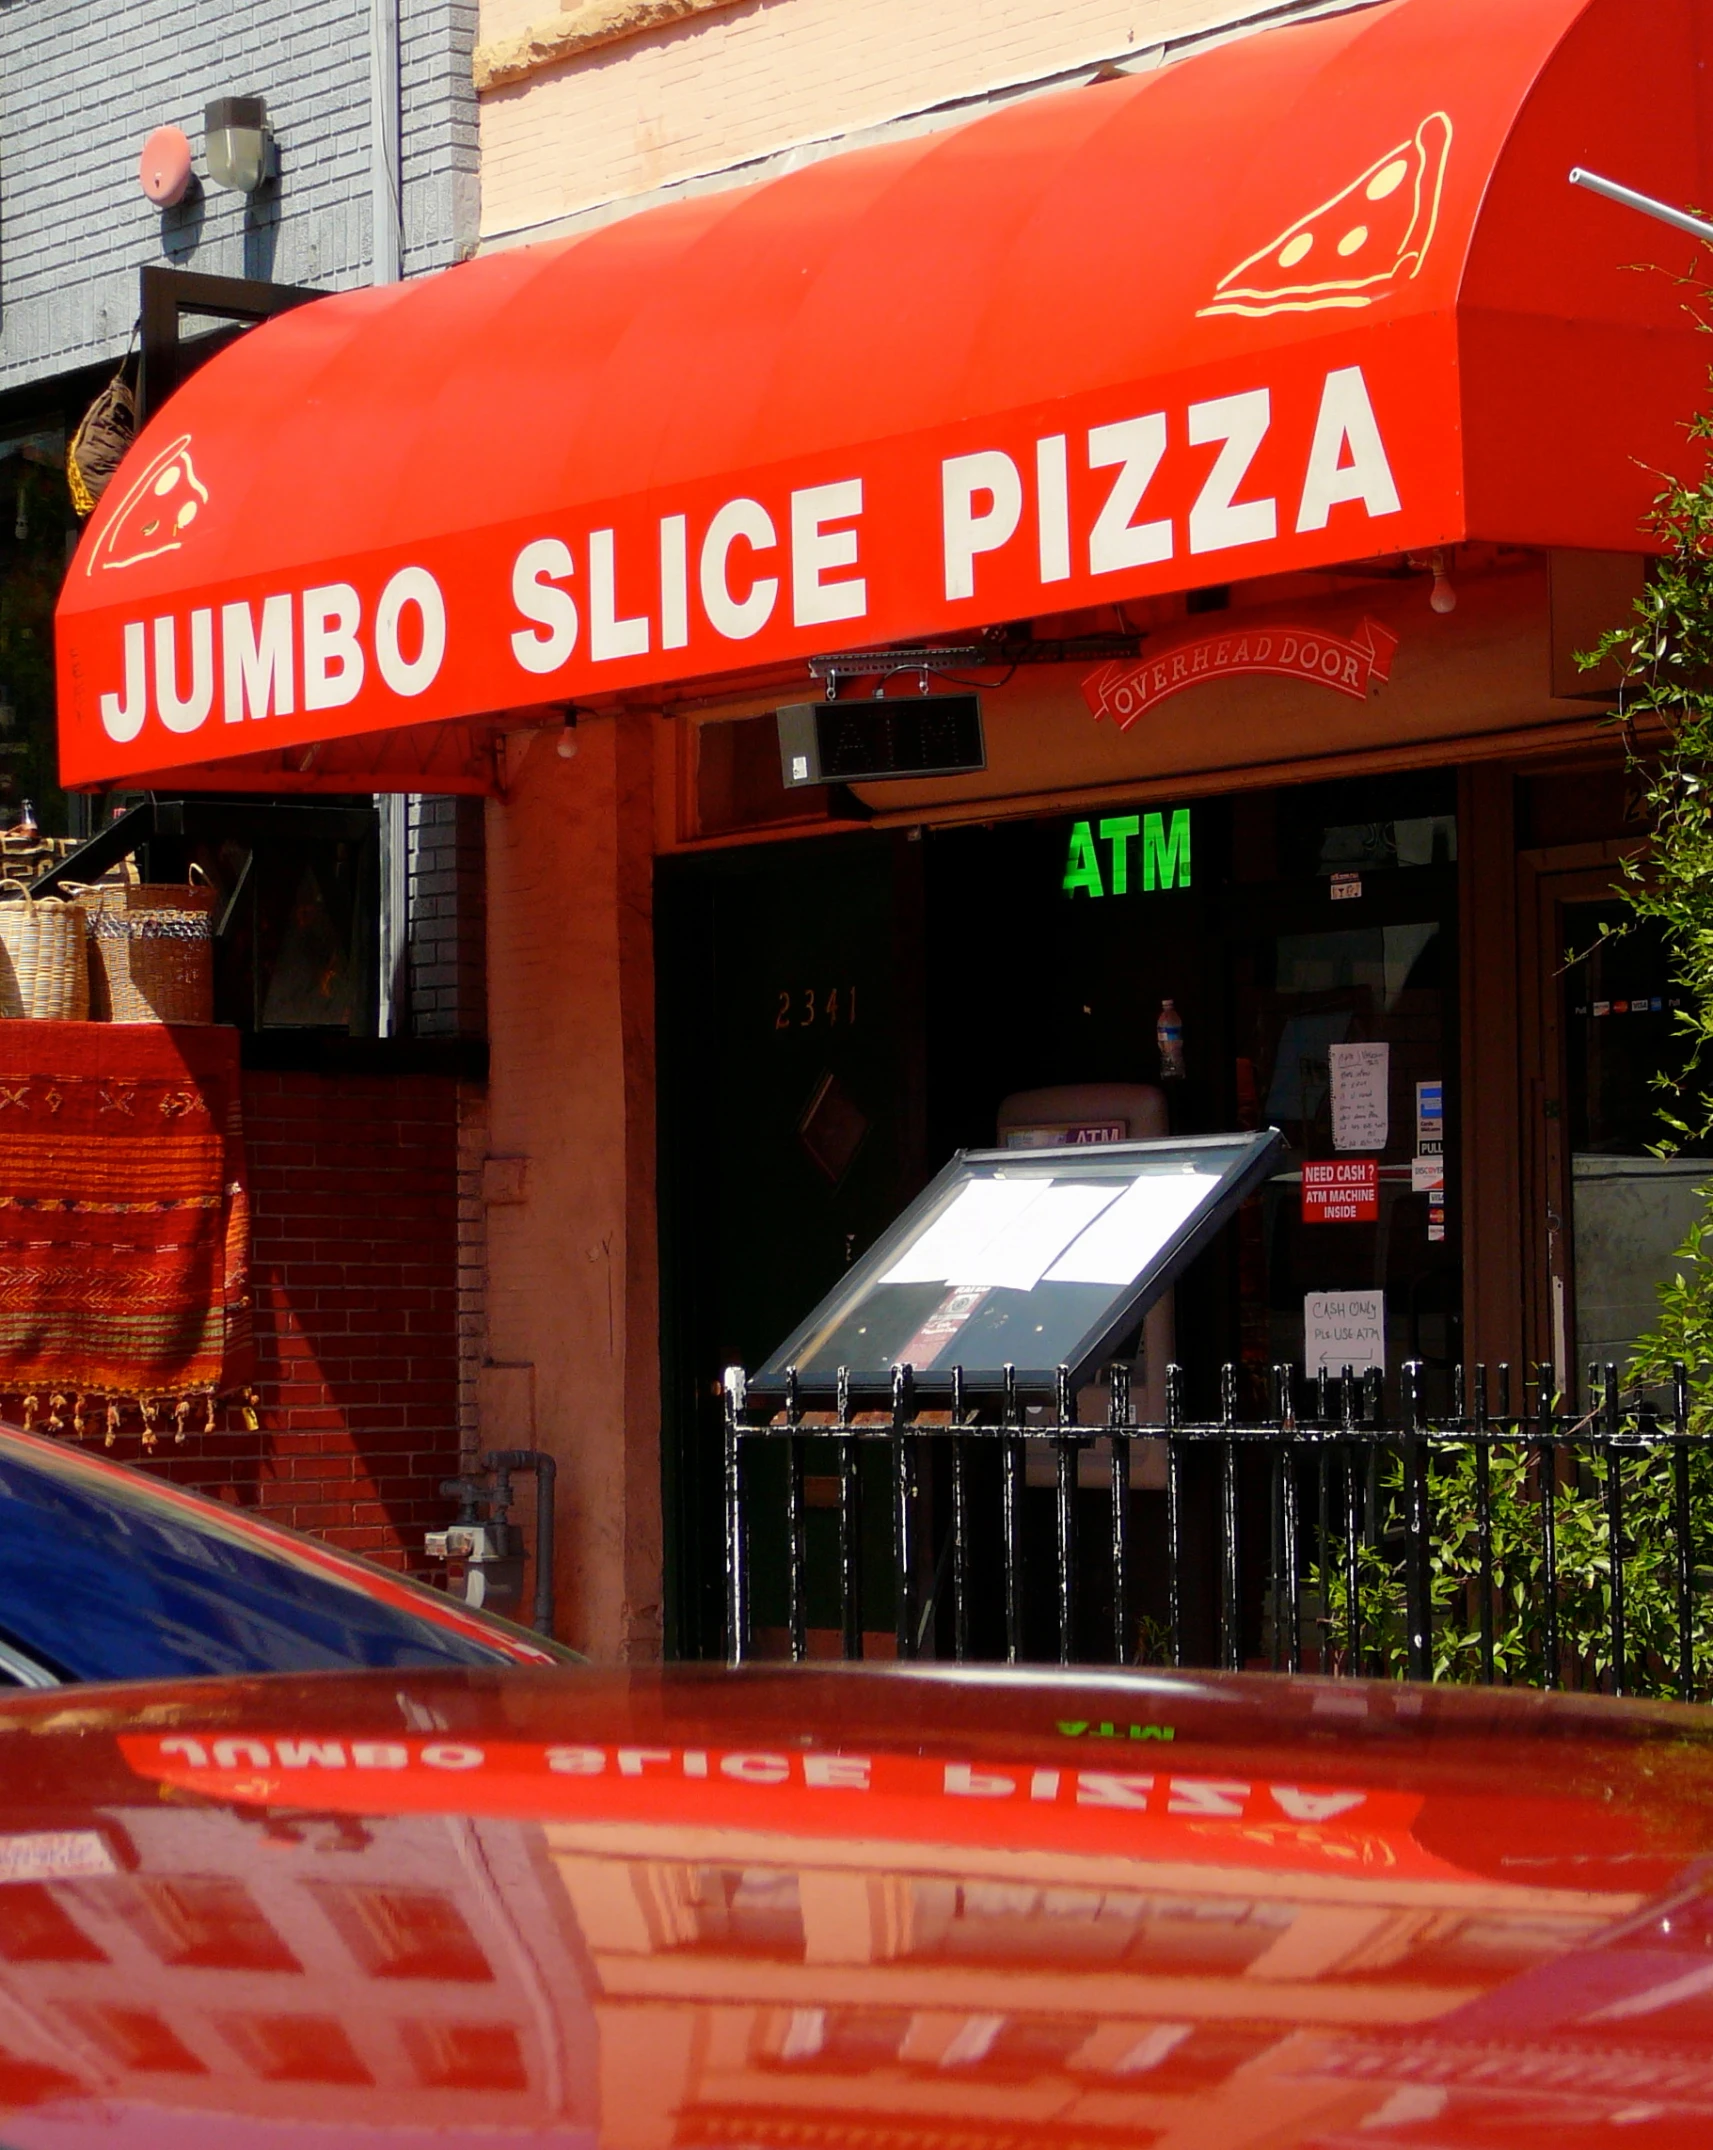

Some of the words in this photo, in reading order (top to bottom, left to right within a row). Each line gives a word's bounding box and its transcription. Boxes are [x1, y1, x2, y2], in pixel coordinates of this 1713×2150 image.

[100, 566, 446, 743] JUMBO
[510, 477, 867, 675] SLICE
[941, 365, 1402, 601] PIZZA
[1115, 637, 1272, 713] OVERHEAD
[1278, 637, 1359, 687] DOOR
[1063, 808, 1191, 898] ATM
[775, 985, 857, 1031] 2341
[1076, 1128, 1119, 1143] ATM
[1421, 1142, 1444, 1154] PULL
[1305, 1166, 1334, 1182] NEED
[1337, 1165, 1365, 1181] CASH
[1306, 1191, 1327, 1203] ATM
[1329, 1189, 1375, 1202] MACHINE
[1324, 1206, 1356, 1218] INSIDE
[1313, 1302, 1346, 1320] CASH
[1334, 1328, 1353, 1341] USE
[1356, 1327, 1380, 1341] ATM
